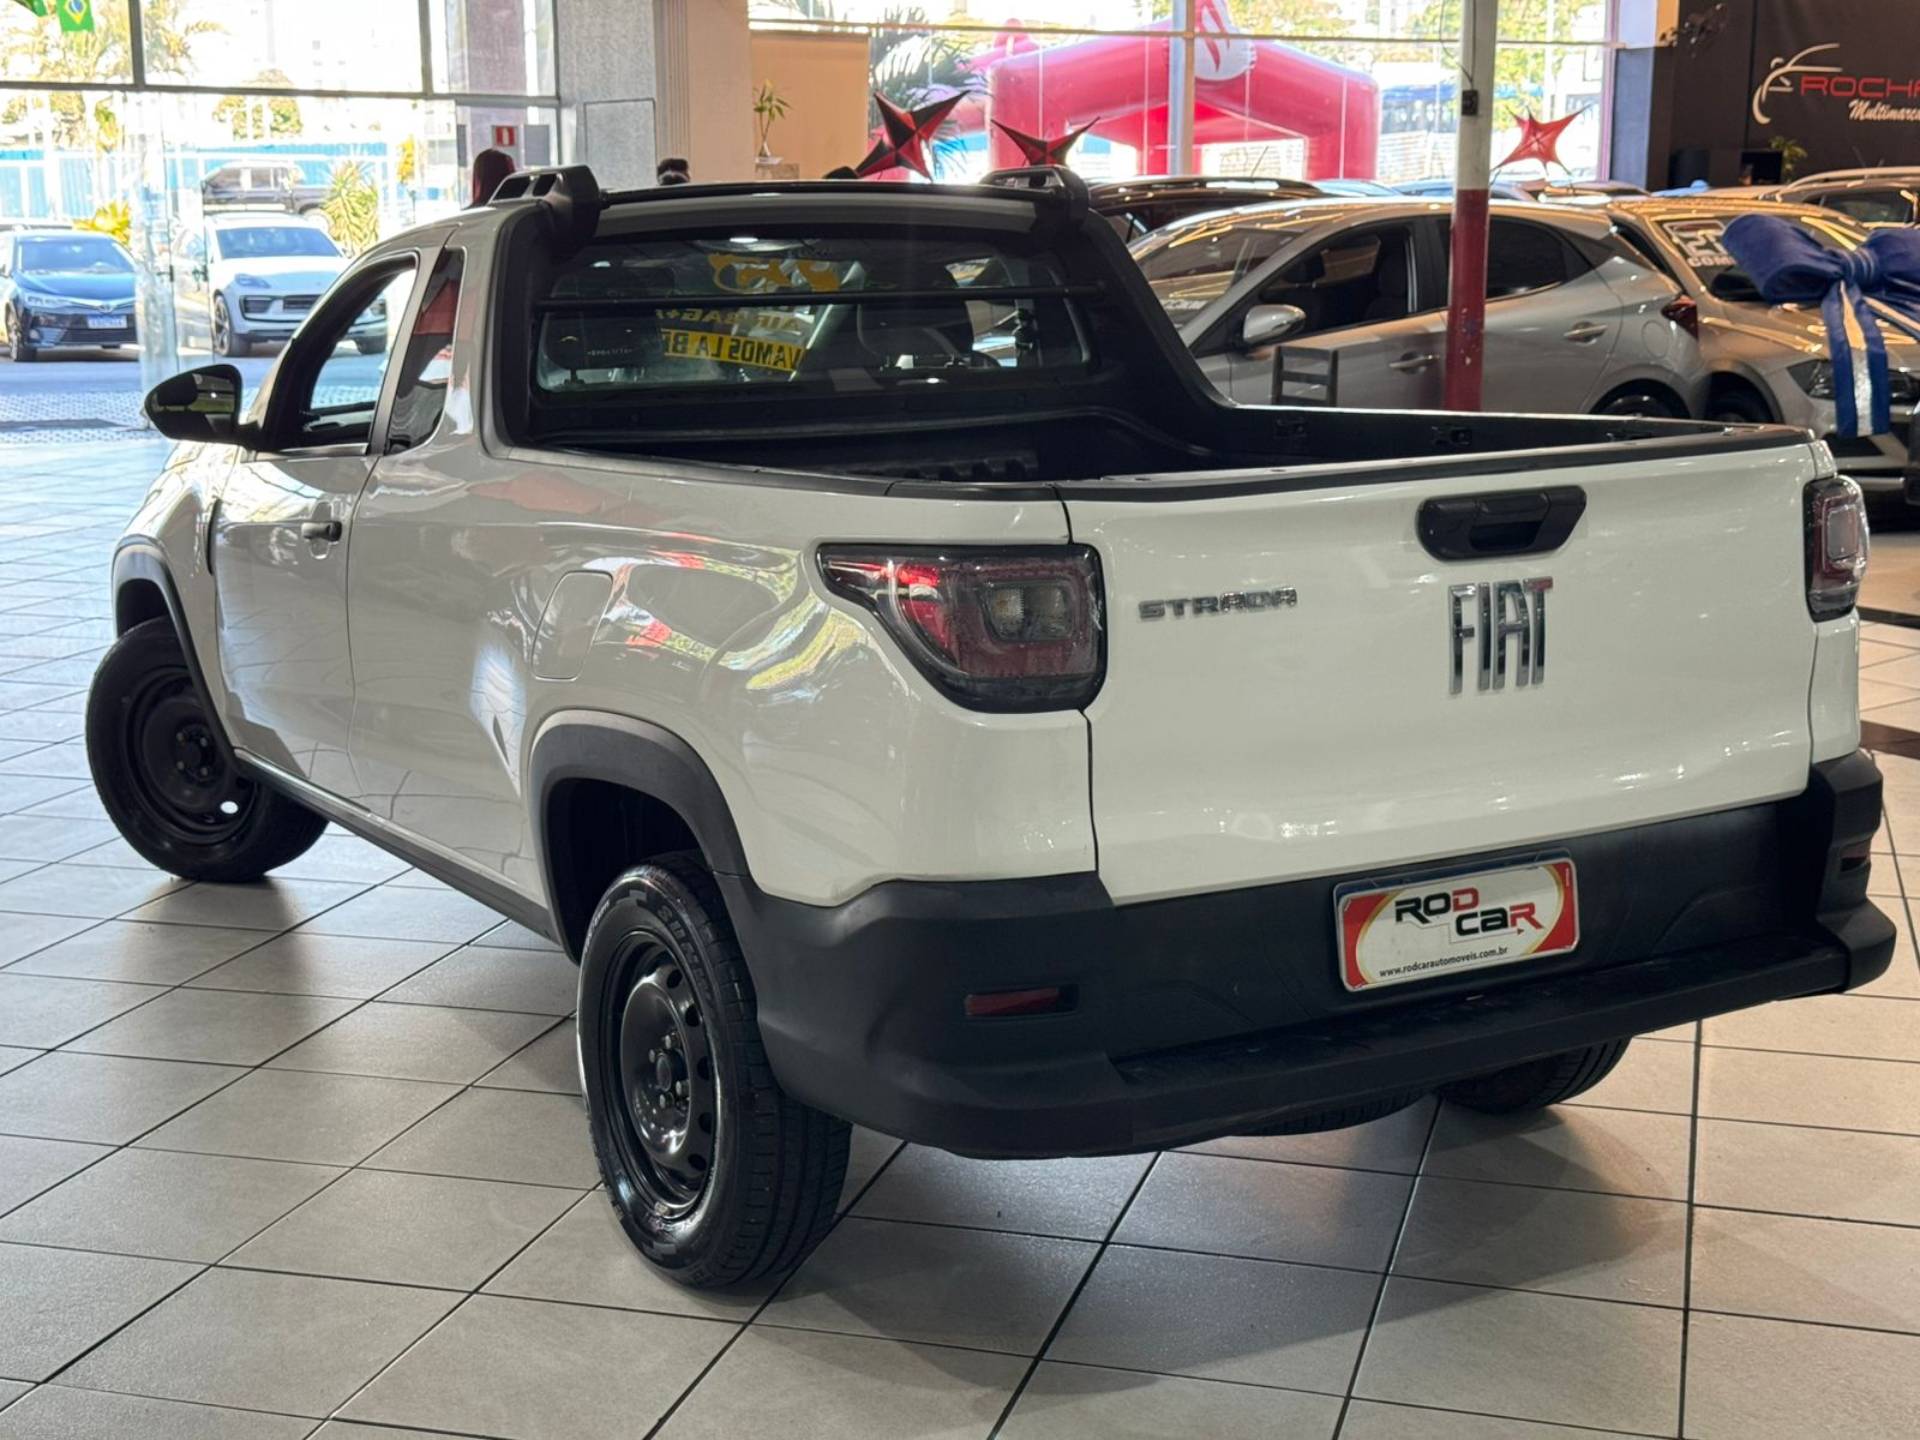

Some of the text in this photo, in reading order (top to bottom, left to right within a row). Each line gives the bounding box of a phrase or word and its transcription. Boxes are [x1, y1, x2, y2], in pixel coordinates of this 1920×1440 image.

[1138, 587, 1298, 620] STRADA
[1448, 576, 1553, 696] FIAT
[1395, 887, 1480, 924] ROD
[1379, 946, 1508, 977] www.rodcarautomoveis.com.br
